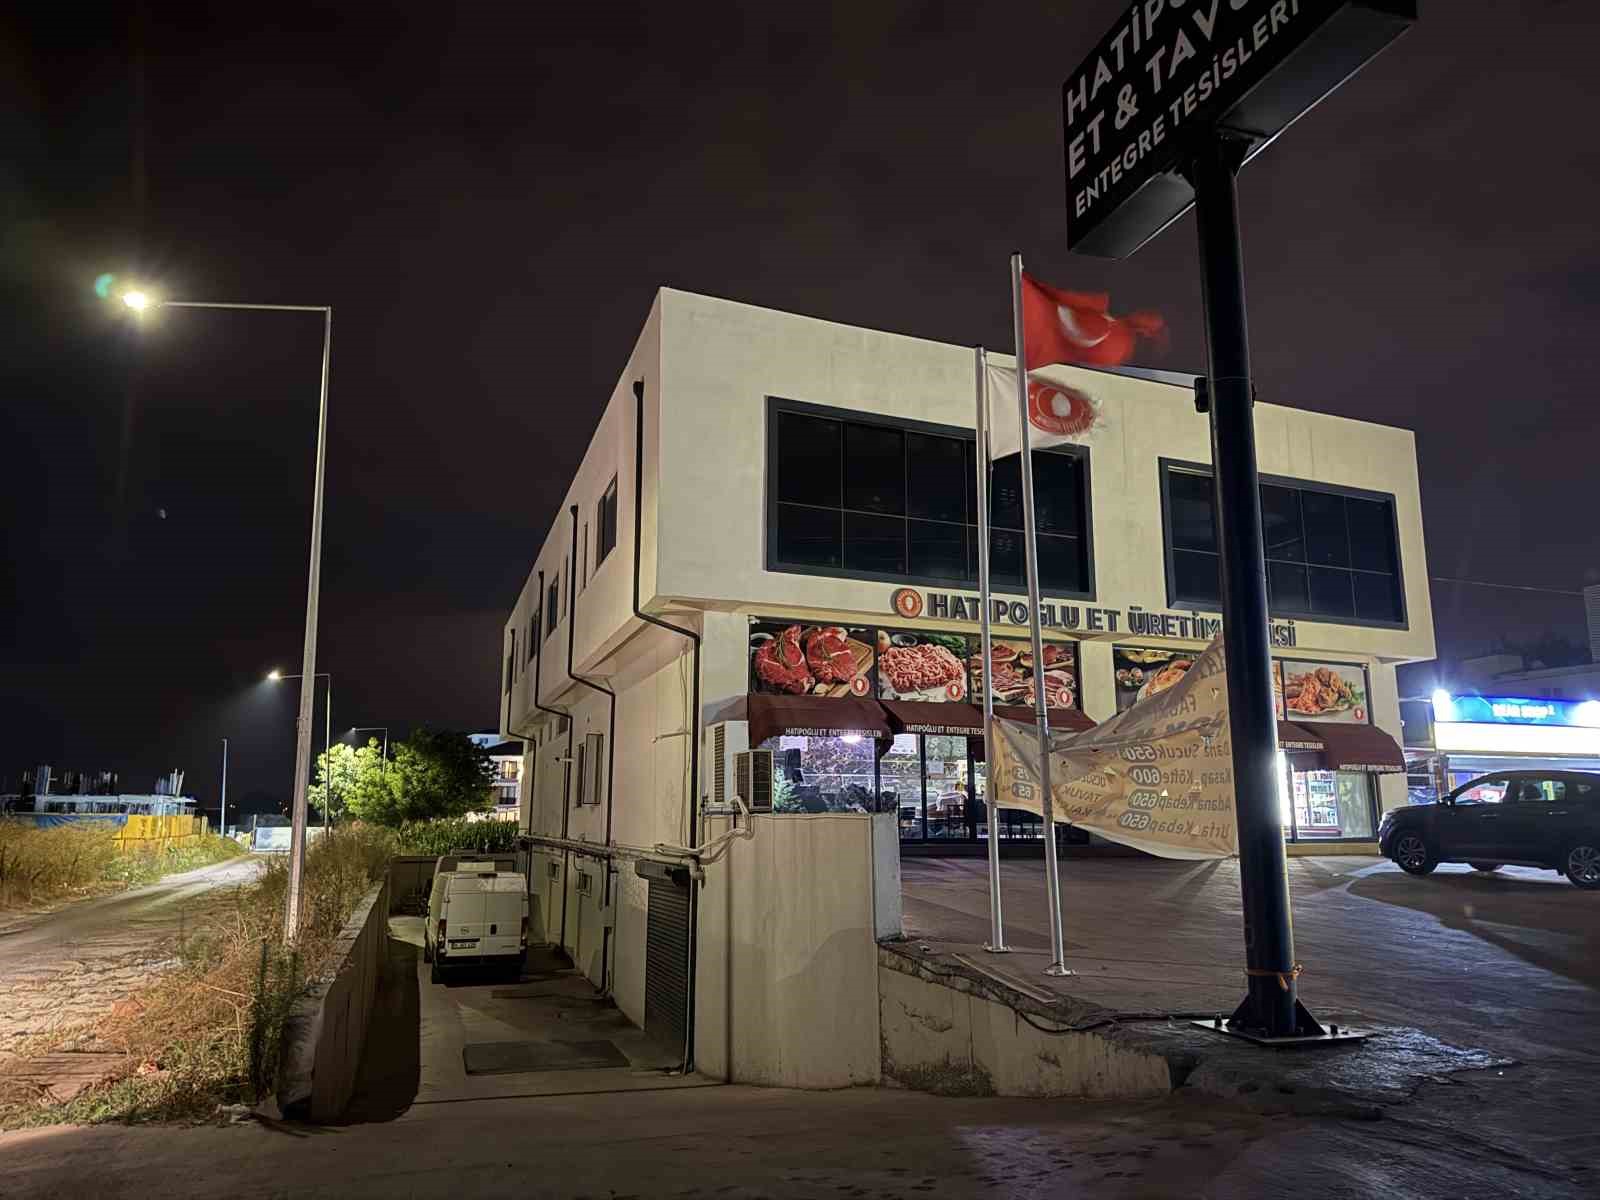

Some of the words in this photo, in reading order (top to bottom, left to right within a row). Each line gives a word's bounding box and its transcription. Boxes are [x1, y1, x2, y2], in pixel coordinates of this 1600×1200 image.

[1068, 110, 1105, 180] ET
[1114, 83, 1139, 131] &
[1075, 115, 1166, 219] ENTEGRE
[1086, 607, 1120, 633] ET
[1127, 605, 1222, 640] ÜRETİM
